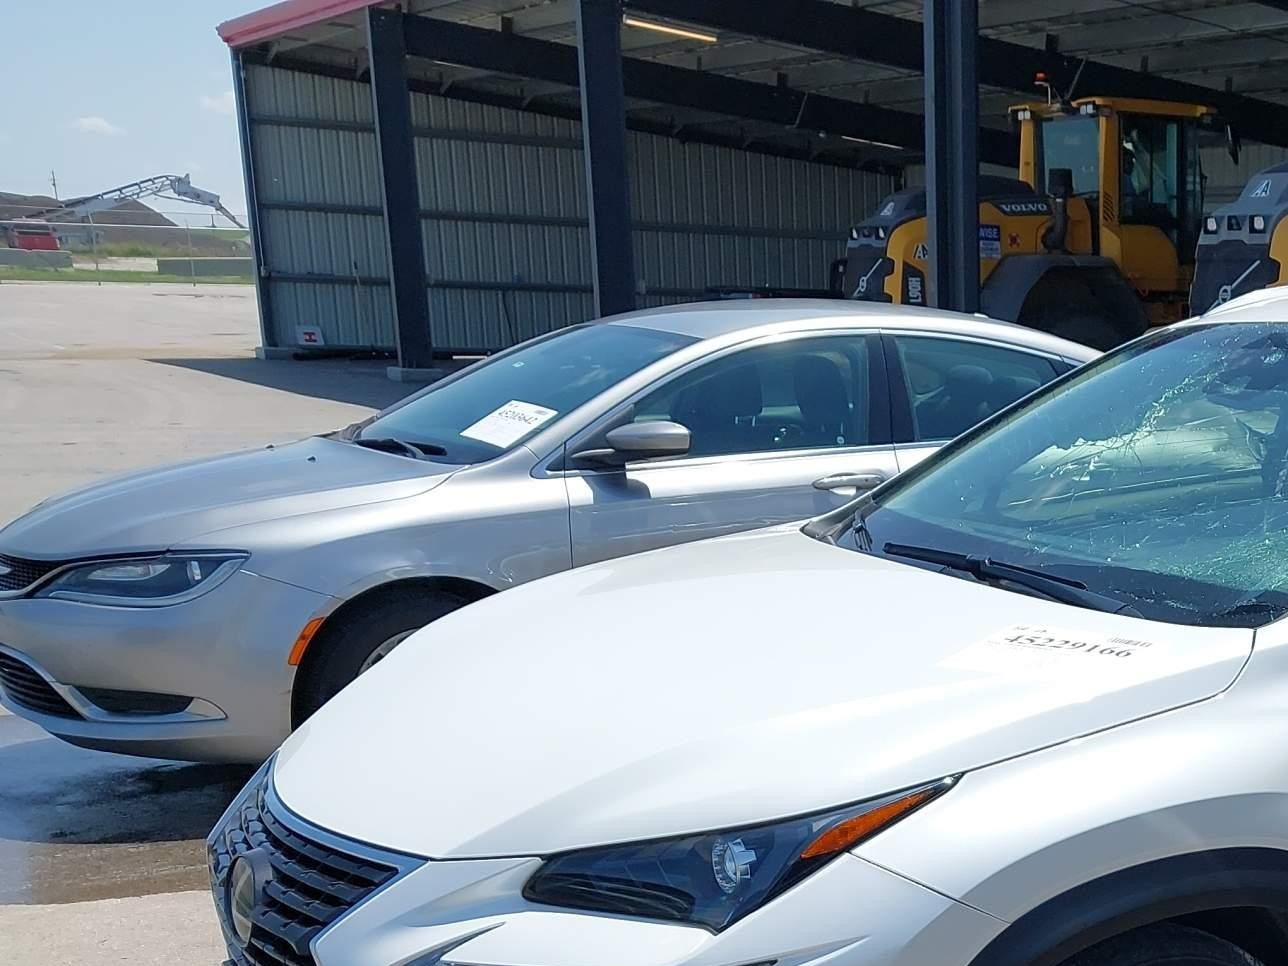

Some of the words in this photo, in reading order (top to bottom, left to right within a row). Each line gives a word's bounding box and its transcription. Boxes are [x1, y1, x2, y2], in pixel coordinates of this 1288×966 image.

[1001, 202, 1047, 212] VOLVO
[908, 277, 922, 302] L90H
[1004, 634, 1132, 658] 45229166
